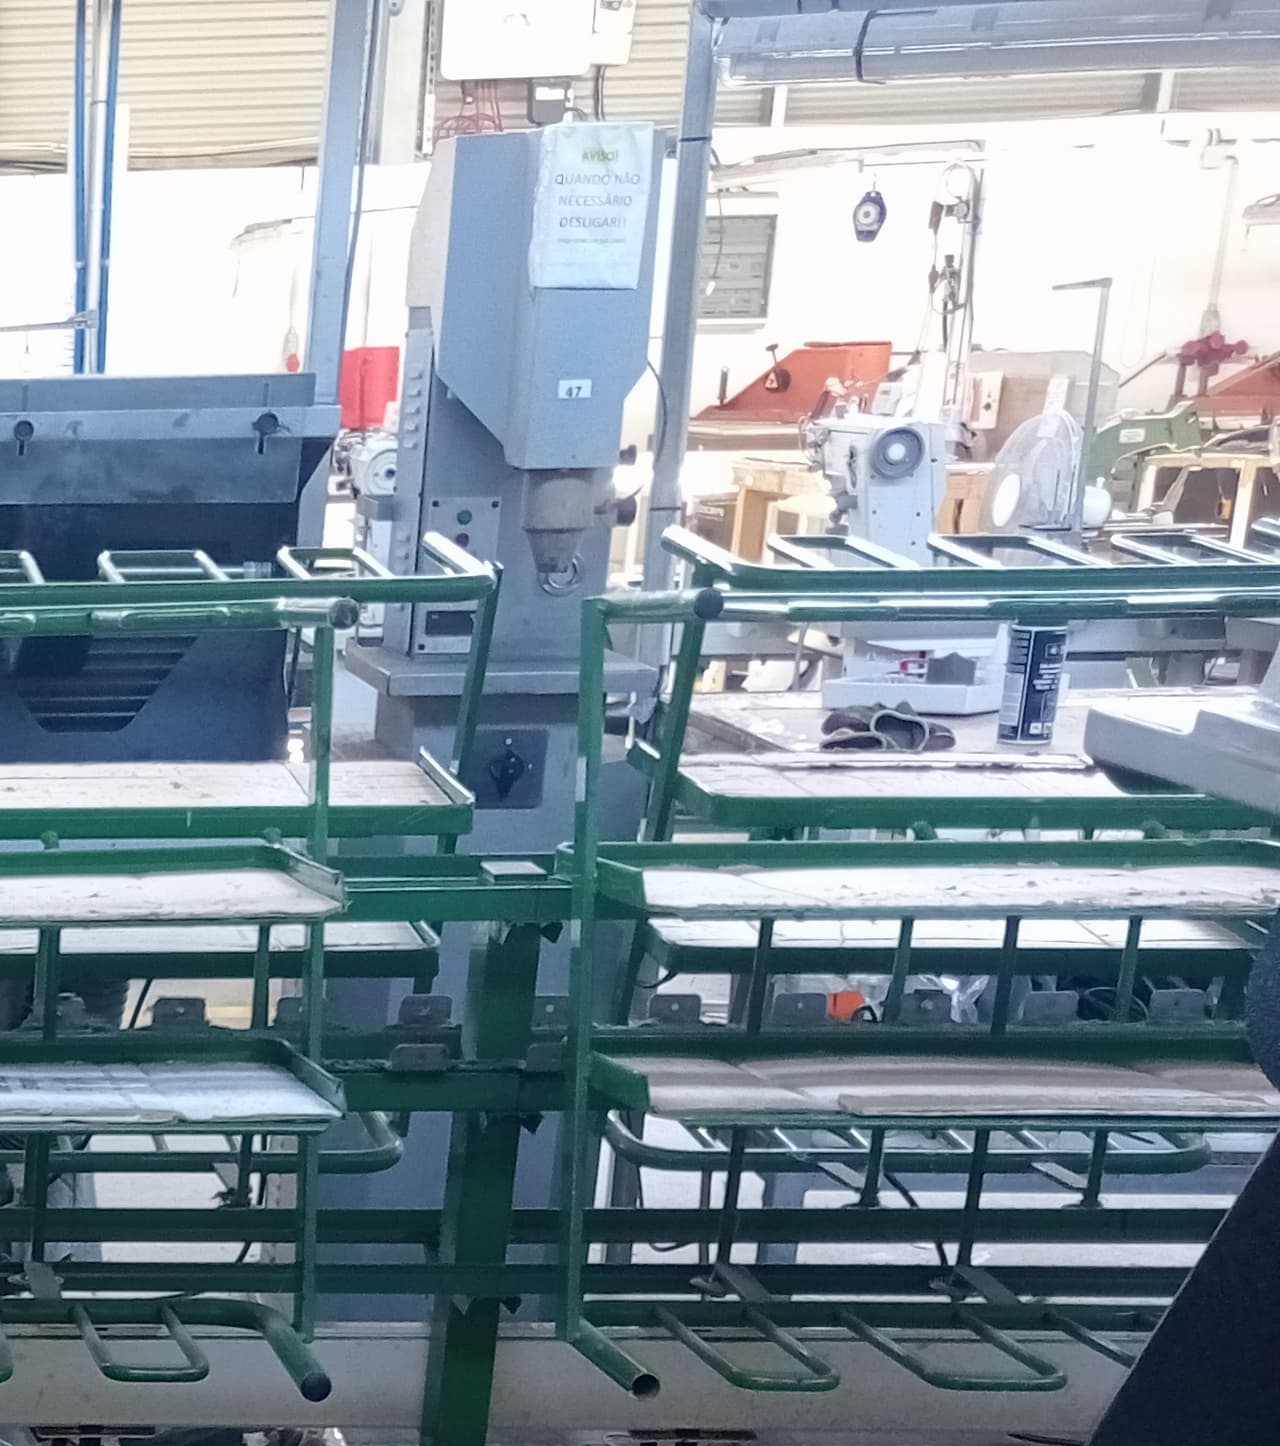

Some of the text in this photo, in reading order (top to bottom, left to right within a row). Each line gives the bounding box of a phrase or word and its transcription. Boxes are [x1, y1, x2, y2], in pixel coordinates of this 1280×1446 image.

[555, 171, 641, 185] QUANDO NÃO
[558, 192, 633, 206] NECESSÁRIO
[565, 386, 583, 399] 47
